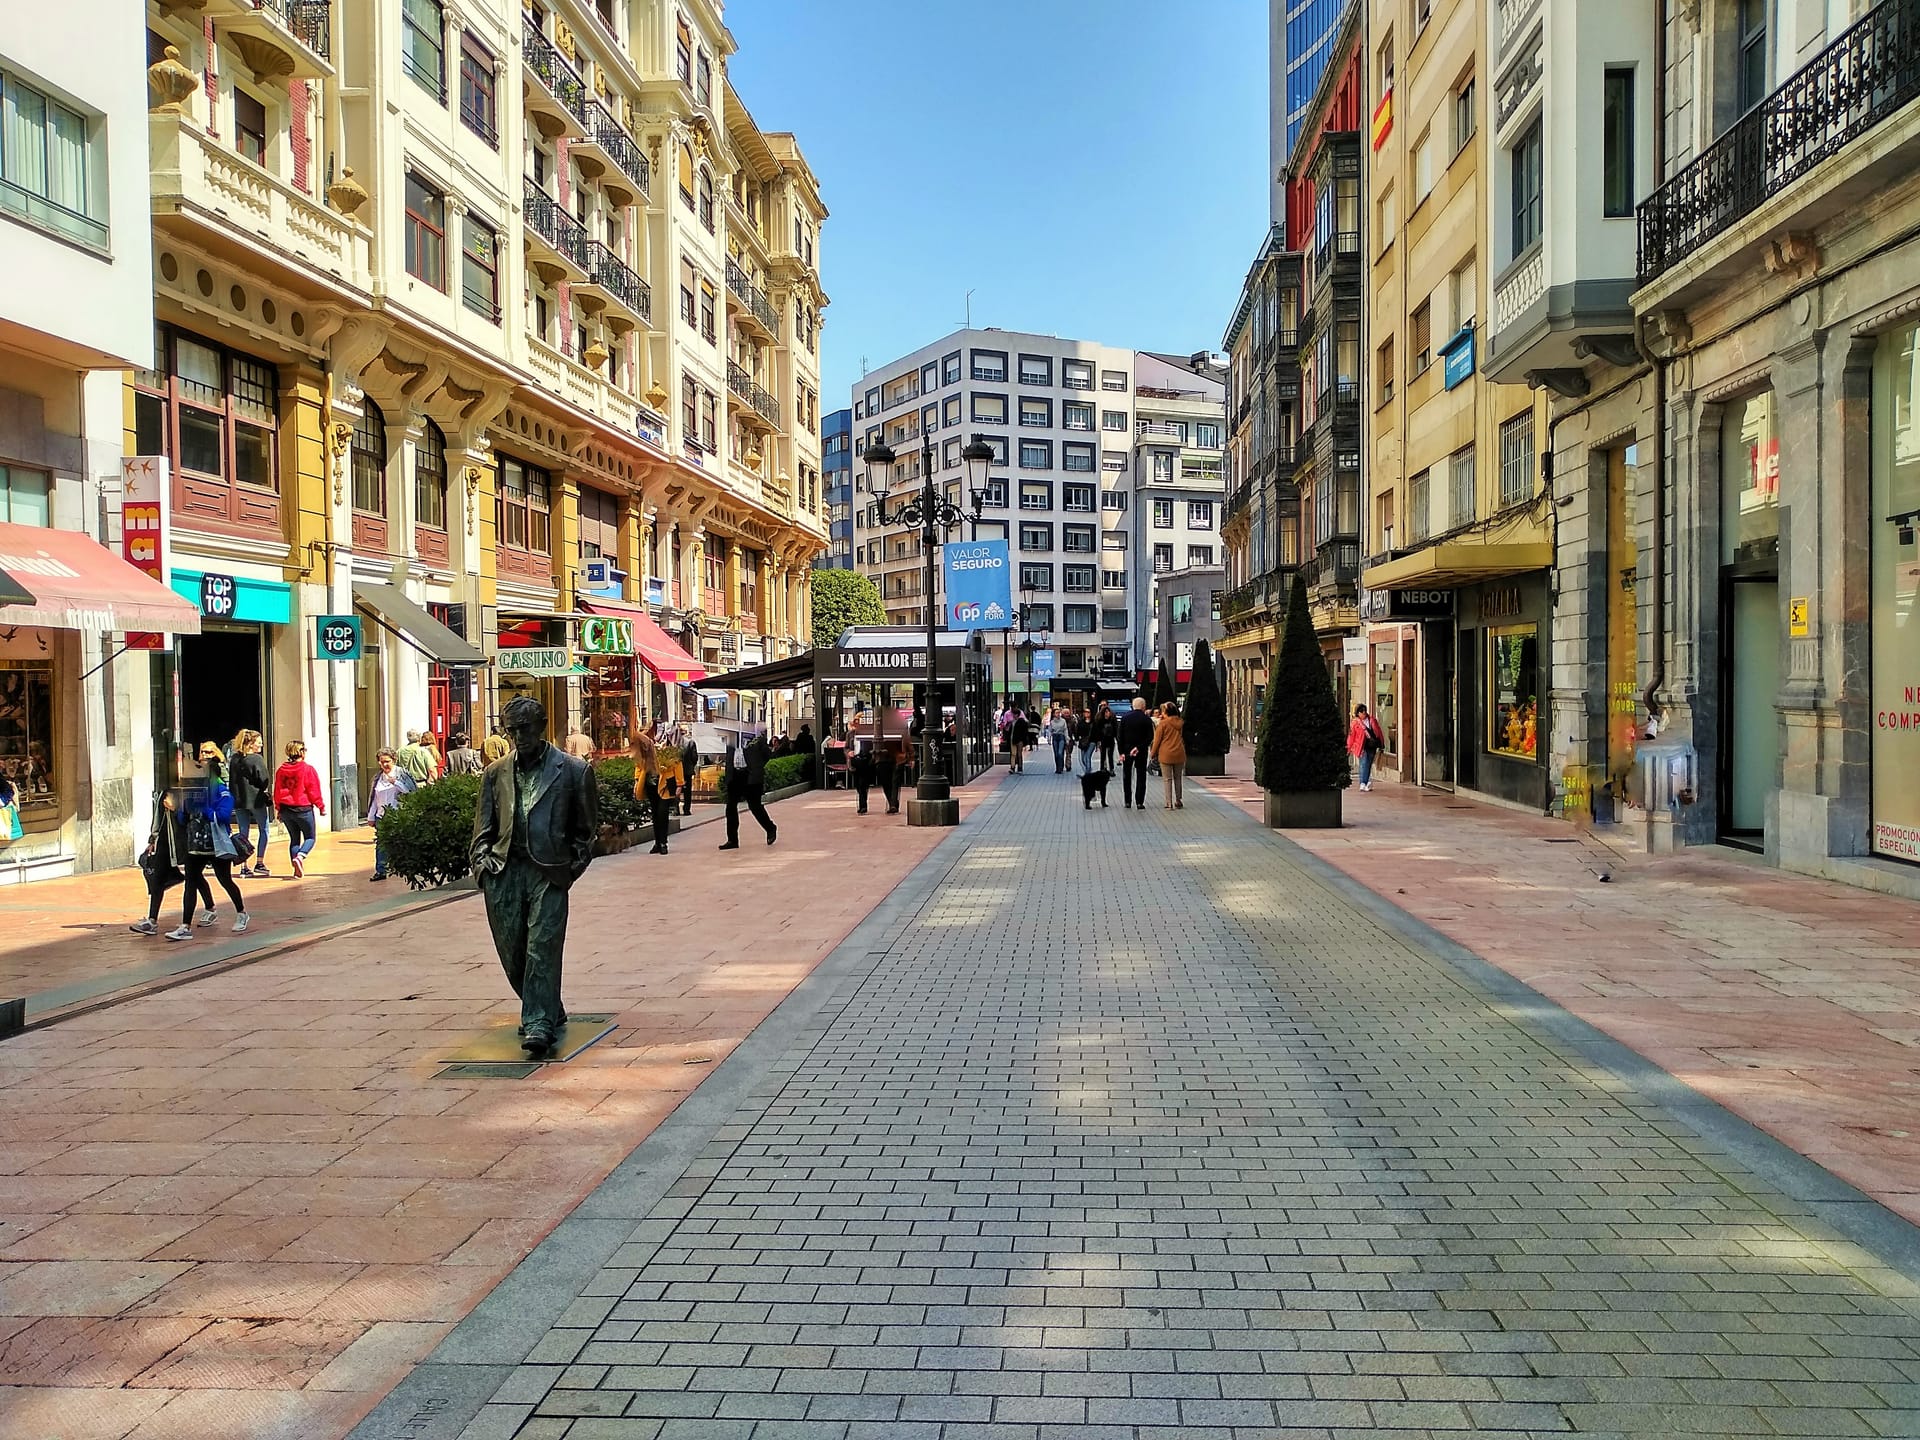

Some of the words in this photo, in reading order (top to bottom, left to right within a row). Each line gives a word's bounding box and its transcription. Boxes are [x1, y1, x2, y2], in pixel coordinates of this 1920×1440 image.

[951, 548, 990, 560] VALOR
[952, 558, 1002, 571] SEGURO
[205, 576, 232, 596] TOP
[205, 595, 232, 614] TOP
[1401, 591, 1450, 604] NEBOT
[984, 613, 1005, 621] FORO
[325, 627, 353, 638] TOP
[325, 639, 353, 651] TOP
[499, 650, 567, 669] CASINO
[839, 653, 856, 668] LA
[859, 653, 910, 668] MALLOR
[1878, 711, 1920, 730] COMP
[1880, 838, 1918, 856] ESPECIAL
